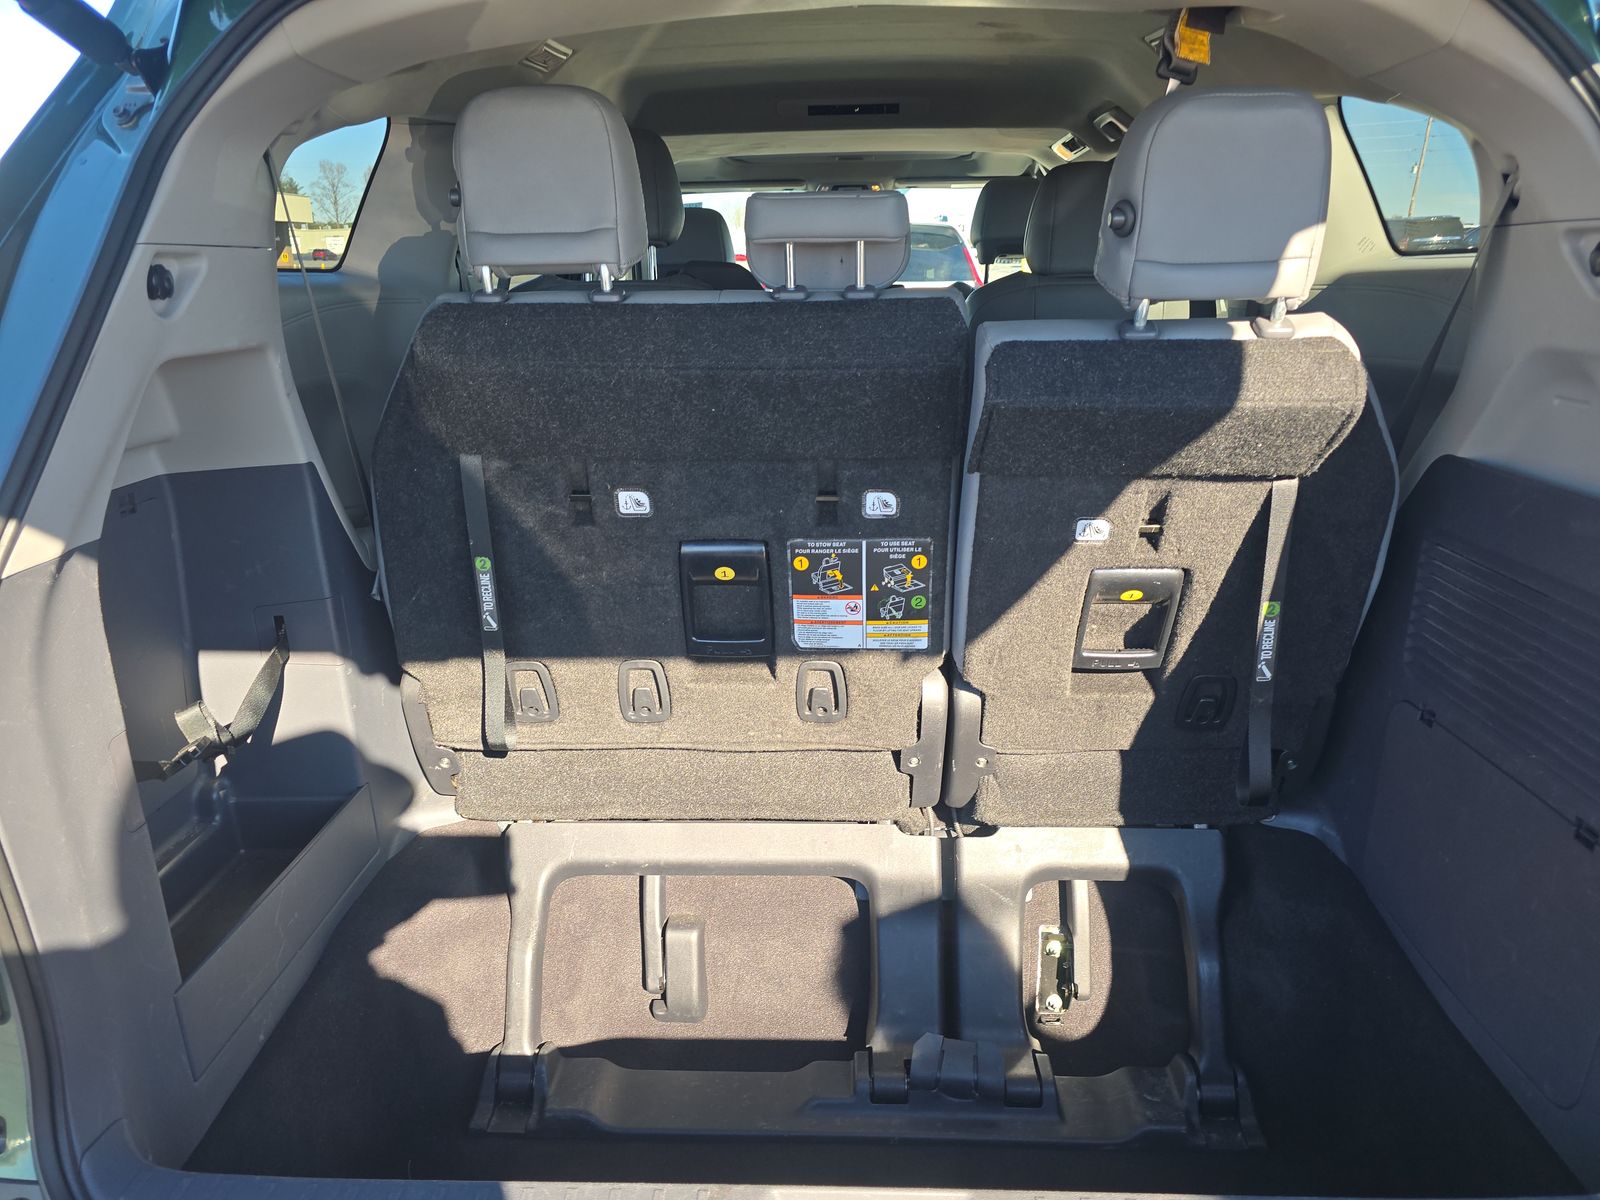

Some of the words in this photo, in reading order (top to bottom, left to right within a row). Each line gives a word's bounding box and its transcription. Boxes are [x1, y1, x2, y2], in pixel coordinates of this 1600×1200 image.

[480, 573, 492, 601] RECLINE
[483, 602, 494, 611] TO
[915, 598, 923, 607] 2
[1262, 619, 1276, 650] RECLINE
[1261, 650, 1272, 660] TO
